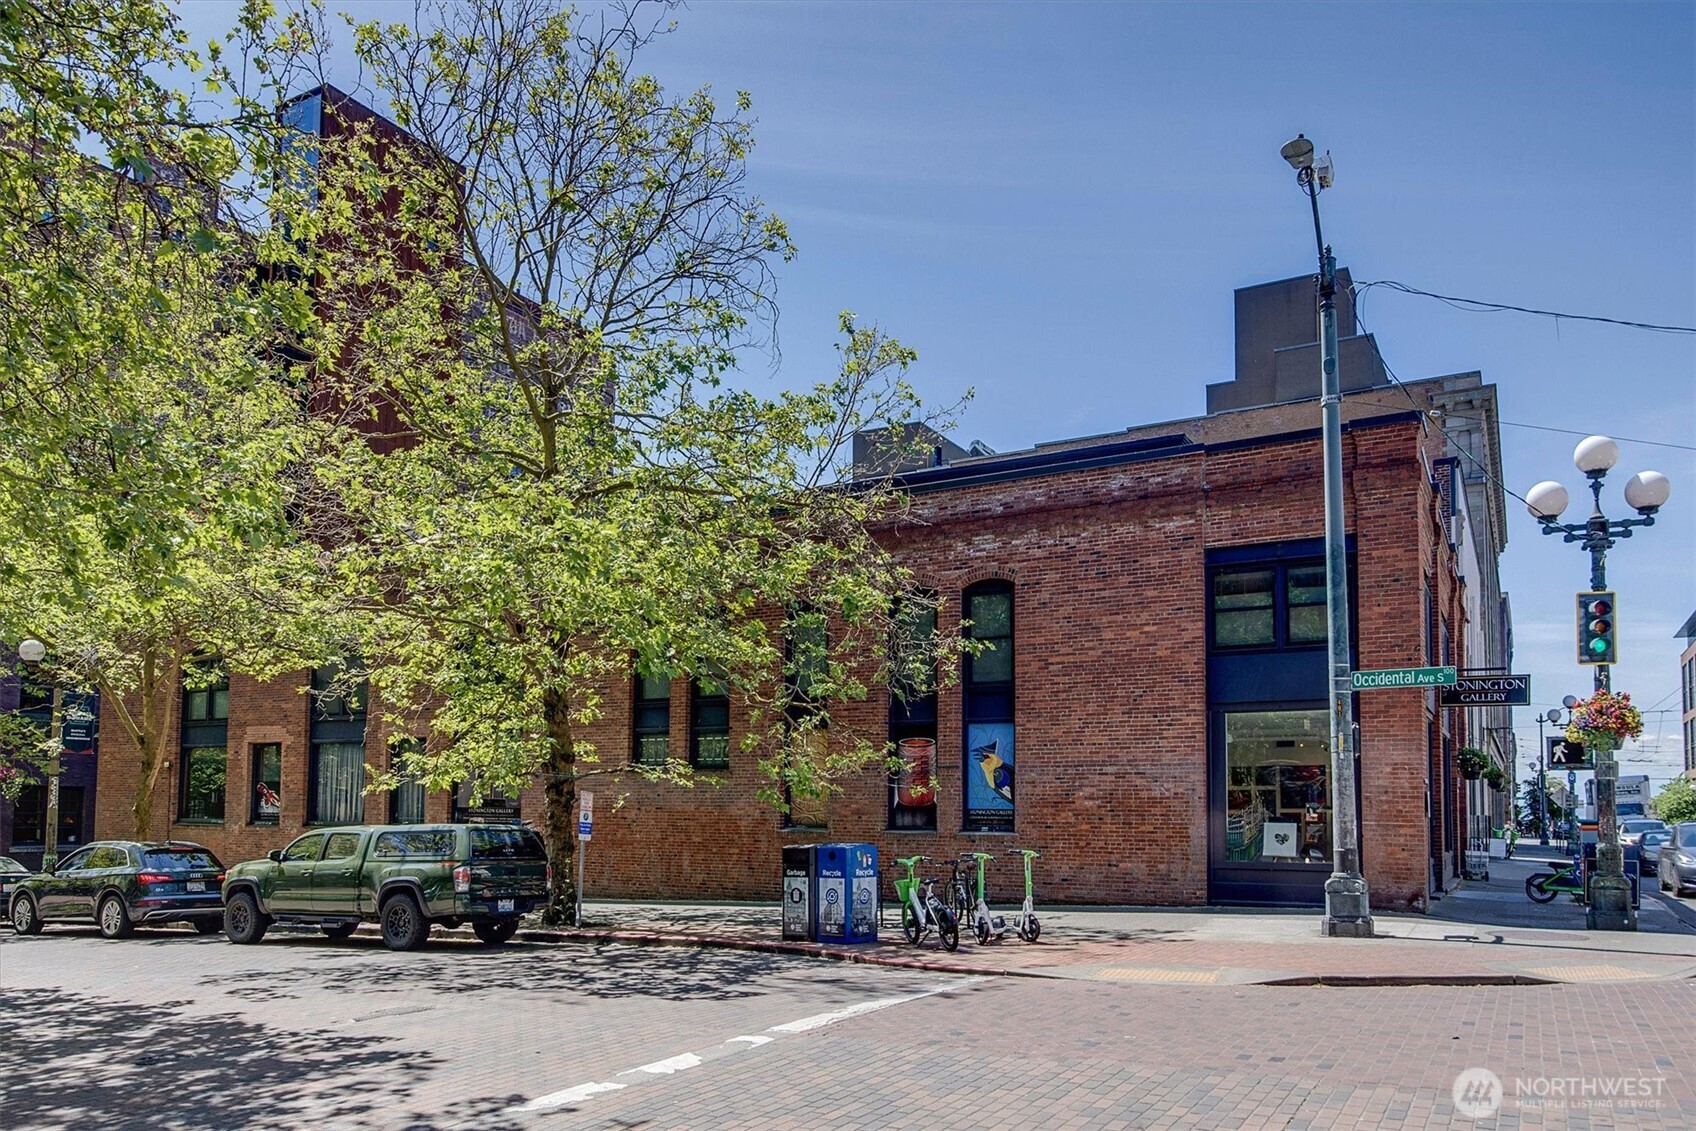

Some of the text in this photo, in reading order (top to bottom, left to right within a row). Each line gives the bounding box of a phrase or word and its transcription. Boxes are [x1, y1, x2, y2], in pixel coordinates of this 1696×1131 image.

[1353, 667, 1454, 687] Occidental Ave S 100
[1442, 678, 1526, 691] STONINGTON
[1460, 692, 1507, 702] GALLERY
[786, 869, 806, 877] Garbage
[822, 869, 842, 877] Recycle
[855, 868, 874, 877] Recycle
